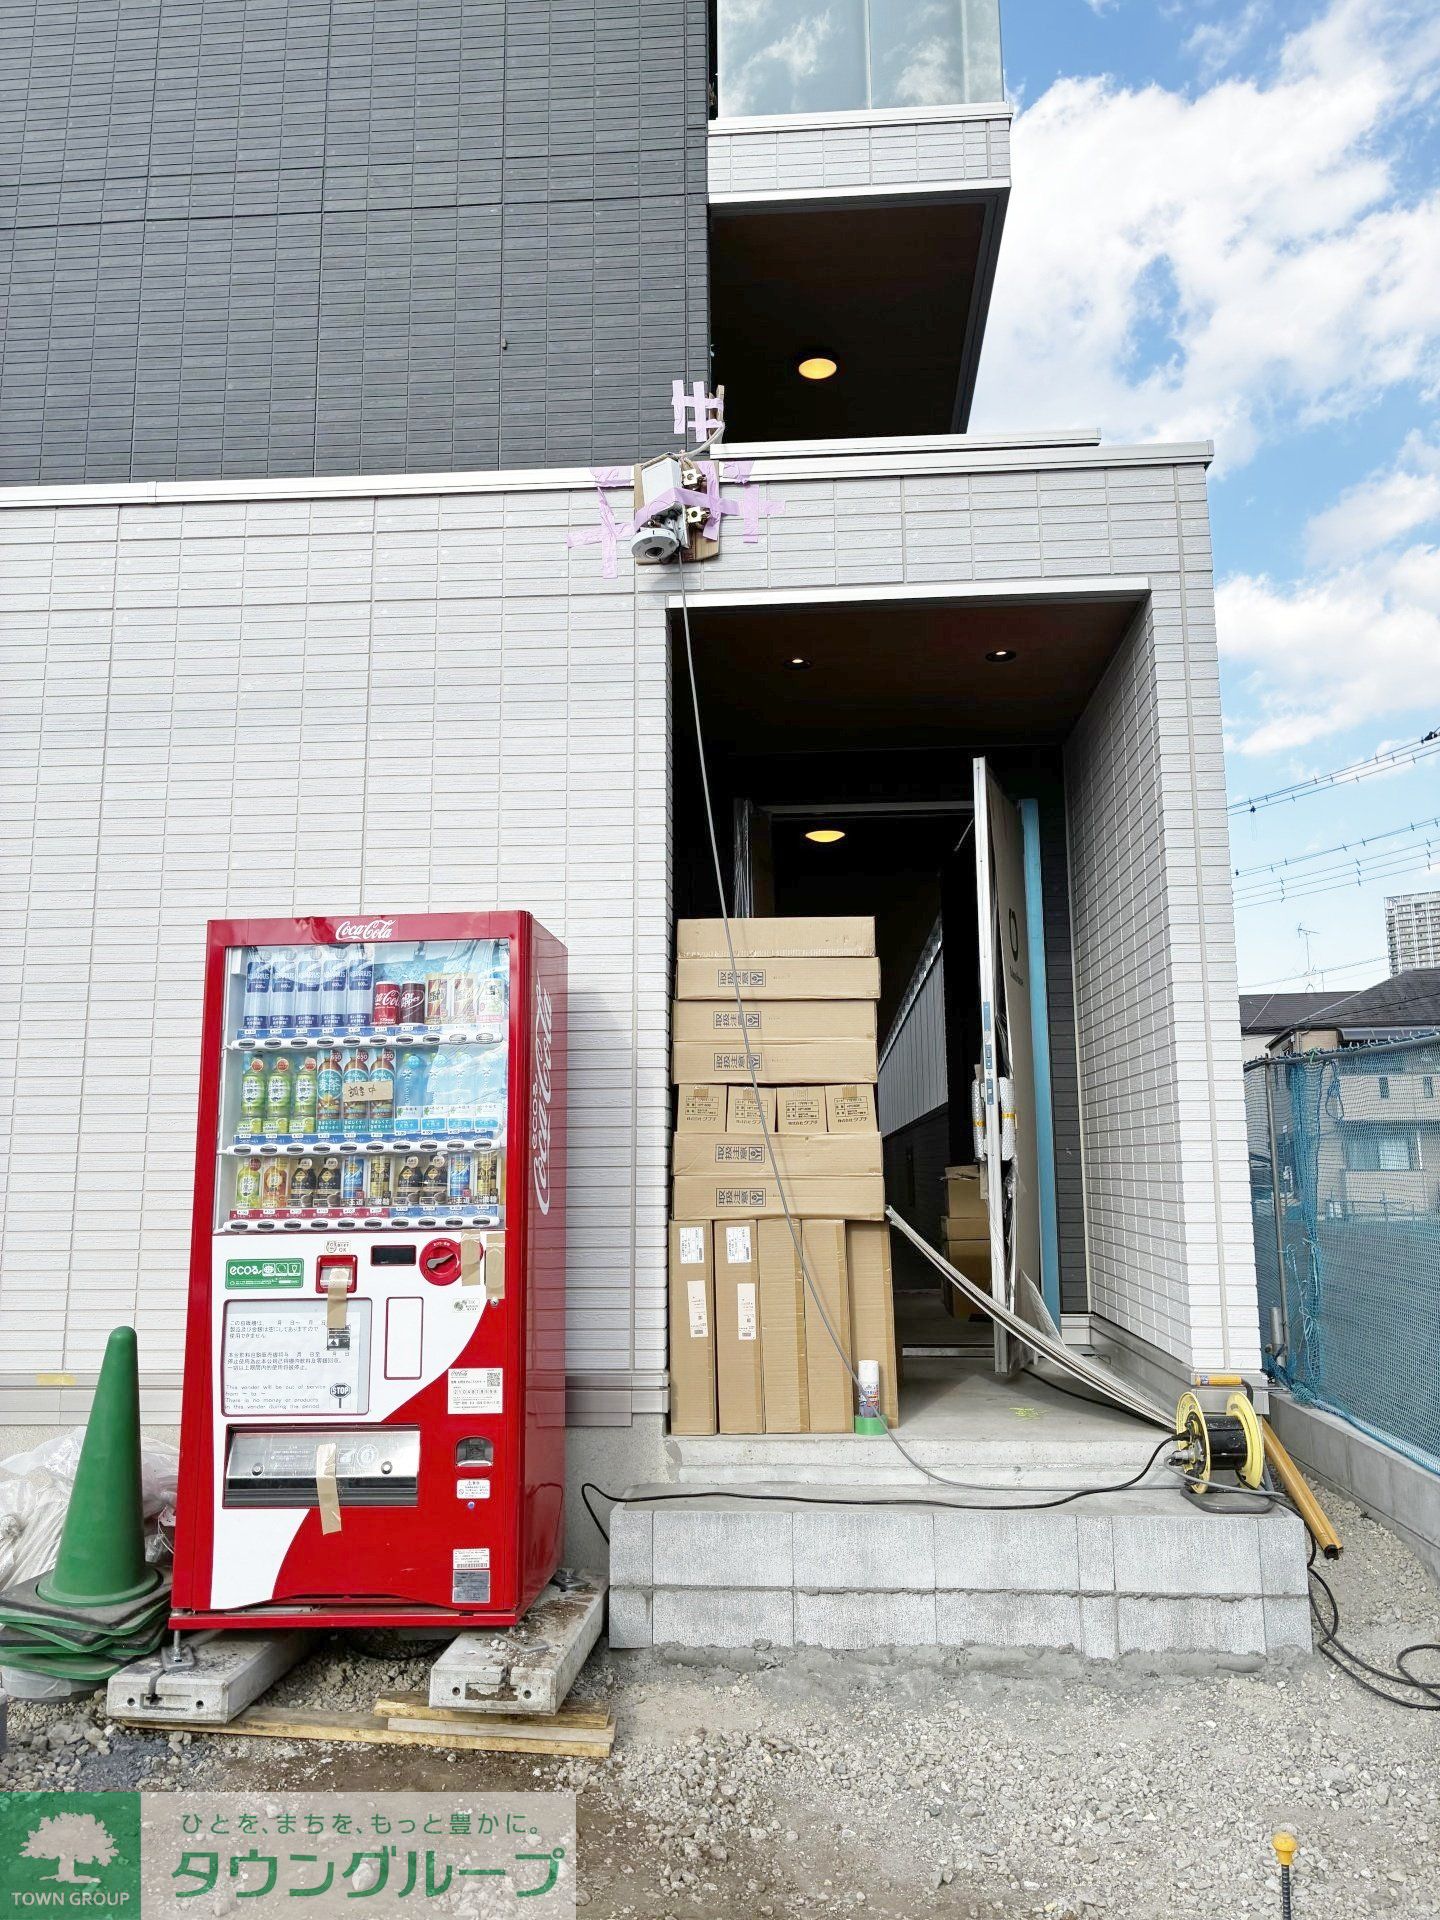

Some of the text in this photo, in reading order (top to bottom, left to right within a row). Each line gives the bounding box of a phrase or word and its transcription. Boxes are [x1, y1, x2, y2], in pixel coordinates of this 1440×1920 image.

[335, 919, 396, 941] Coca-Cola
[718, 1146, 748, 1160] 取扱注意
[718, 1190, 748, 1204] 取扱注意
[331, 1386, 348, 1395] STOP
